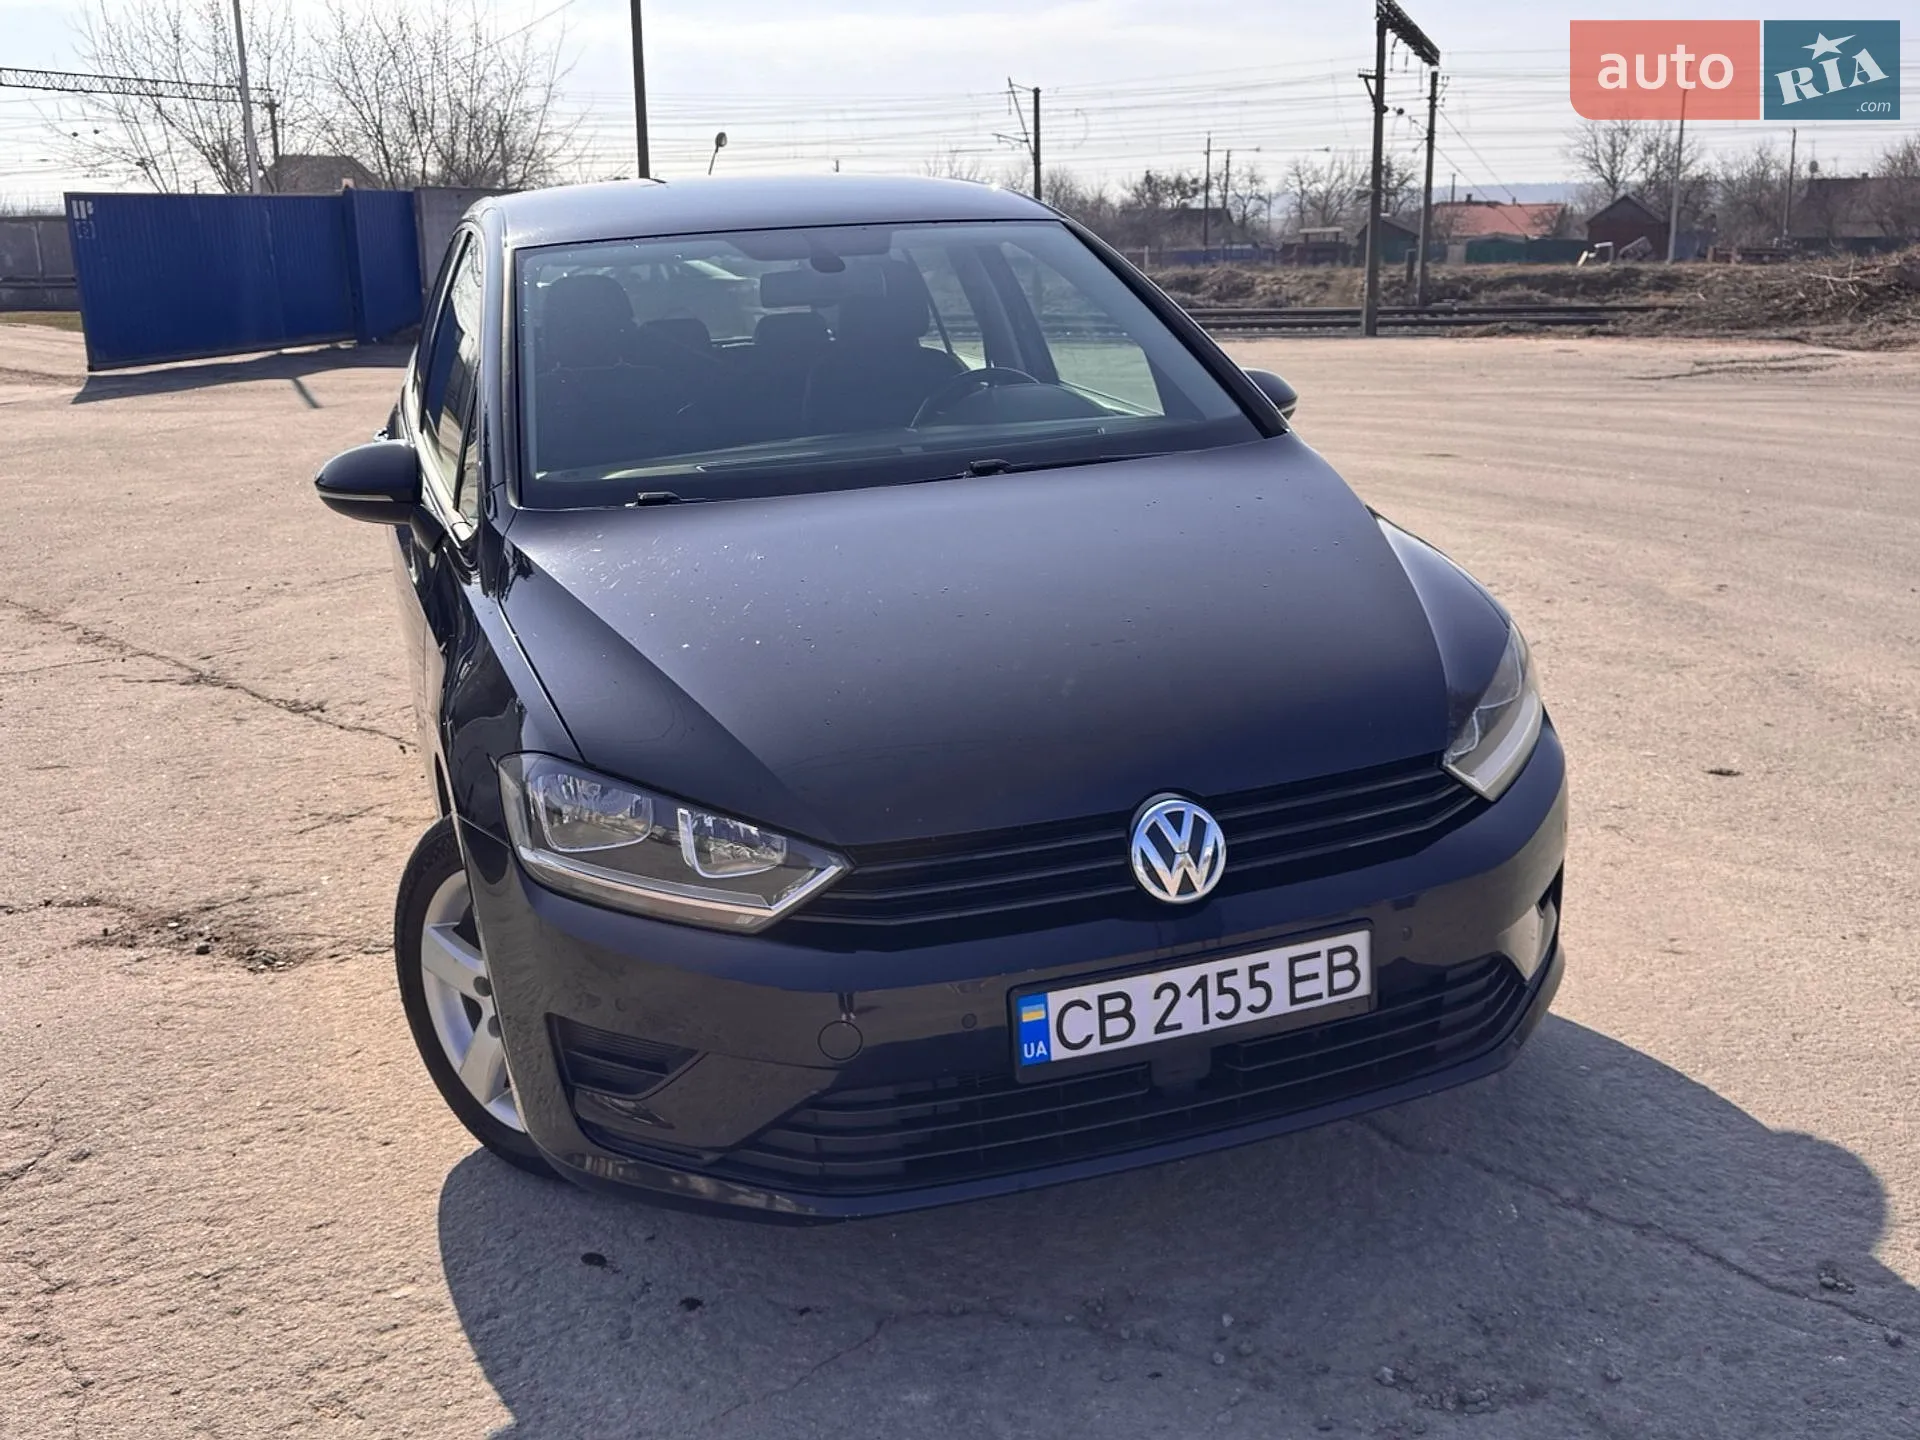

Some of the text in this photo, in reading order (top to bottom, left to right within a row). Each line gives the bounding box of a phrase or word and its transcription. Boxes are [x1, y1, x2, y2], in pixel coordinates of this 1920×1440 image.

[1131, 799, 1227, 904] VW
[1023, 1040, 1048, 1058] UA
[1055, 945, 1362, 1051] CB 2155 EB
